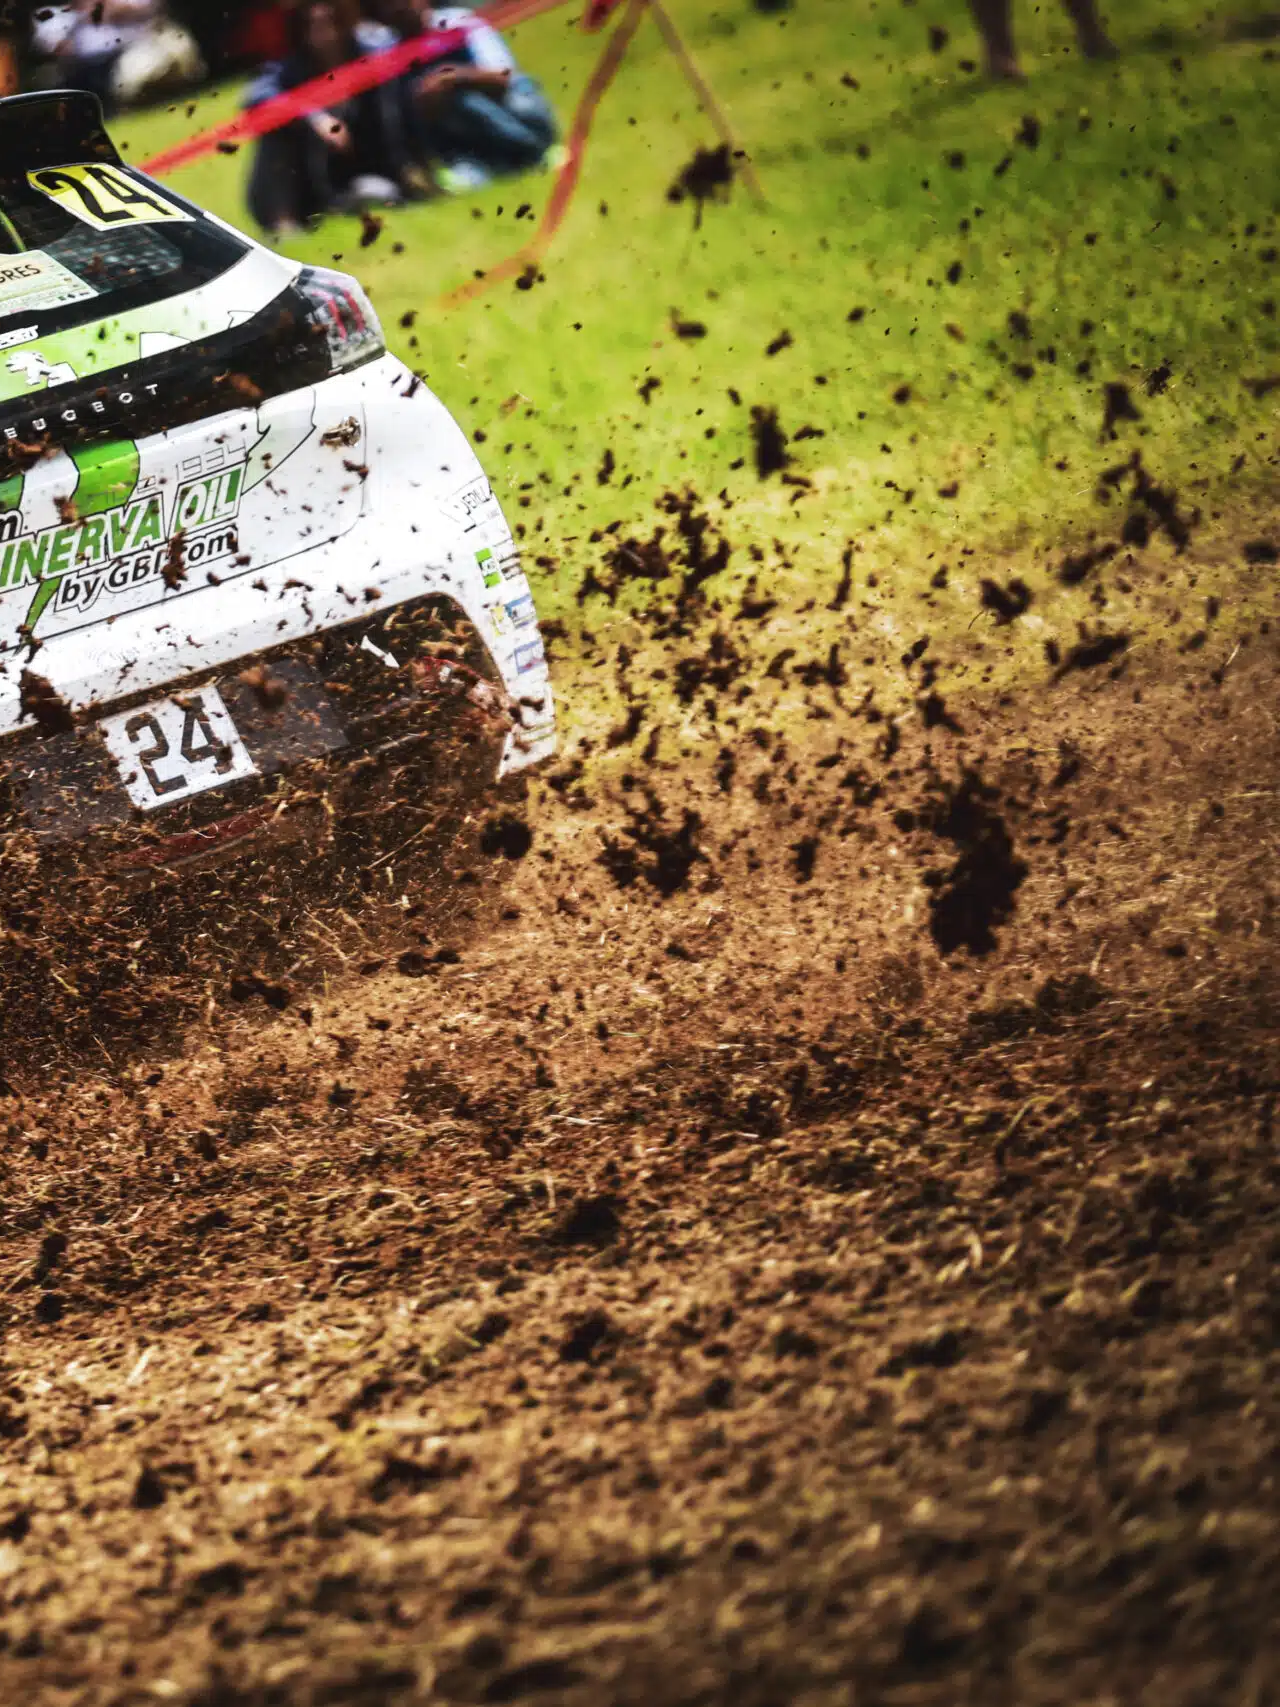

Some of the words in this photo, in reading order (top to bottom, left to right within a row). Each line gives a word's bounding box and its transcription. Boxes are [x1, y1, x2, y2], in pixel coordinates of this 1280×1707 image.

[35, 166, 174, 223] 24
[179, 472, 237, 529] OIL
[61, 576, 101, 605] by
[123, 694, 234, 797] 24
